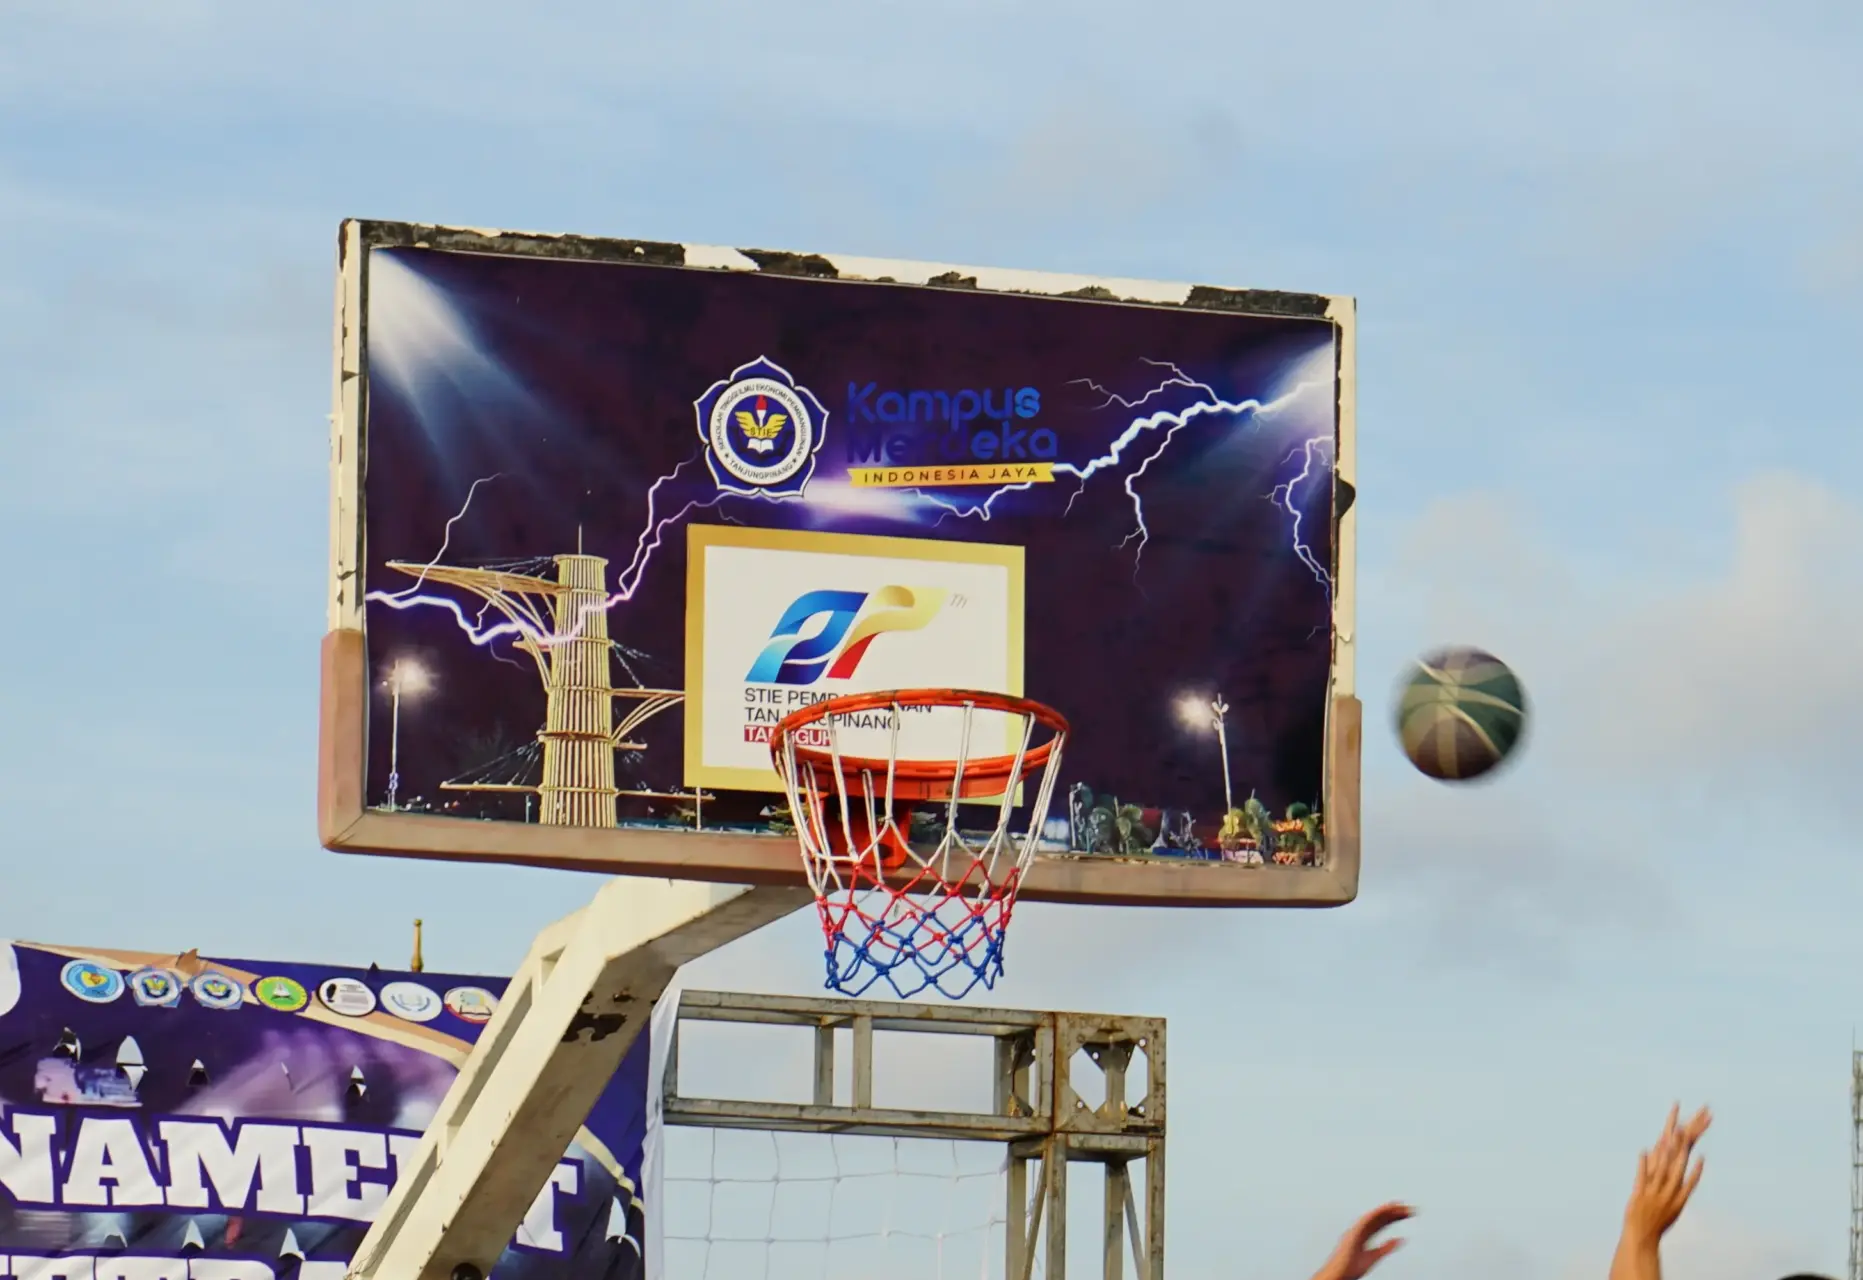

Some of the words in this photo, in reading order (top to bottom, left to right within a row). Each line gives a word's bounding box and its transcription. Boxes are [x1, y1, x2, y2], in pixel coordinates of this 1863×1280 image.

[756, 383, 789, 400] EKONOMI
[847, 381, 1041, 432] Kampus
[750, 427, 774, 437] STIE
[847, 421, 1059, 464] Merdeka
[729, 460, 793, 479] TANJUNGPINANG
[864, 467, 980, 484] INDONESIA
[988, 467, 1038, 480] JAYA
[745, 687, 783, 704] STIE
